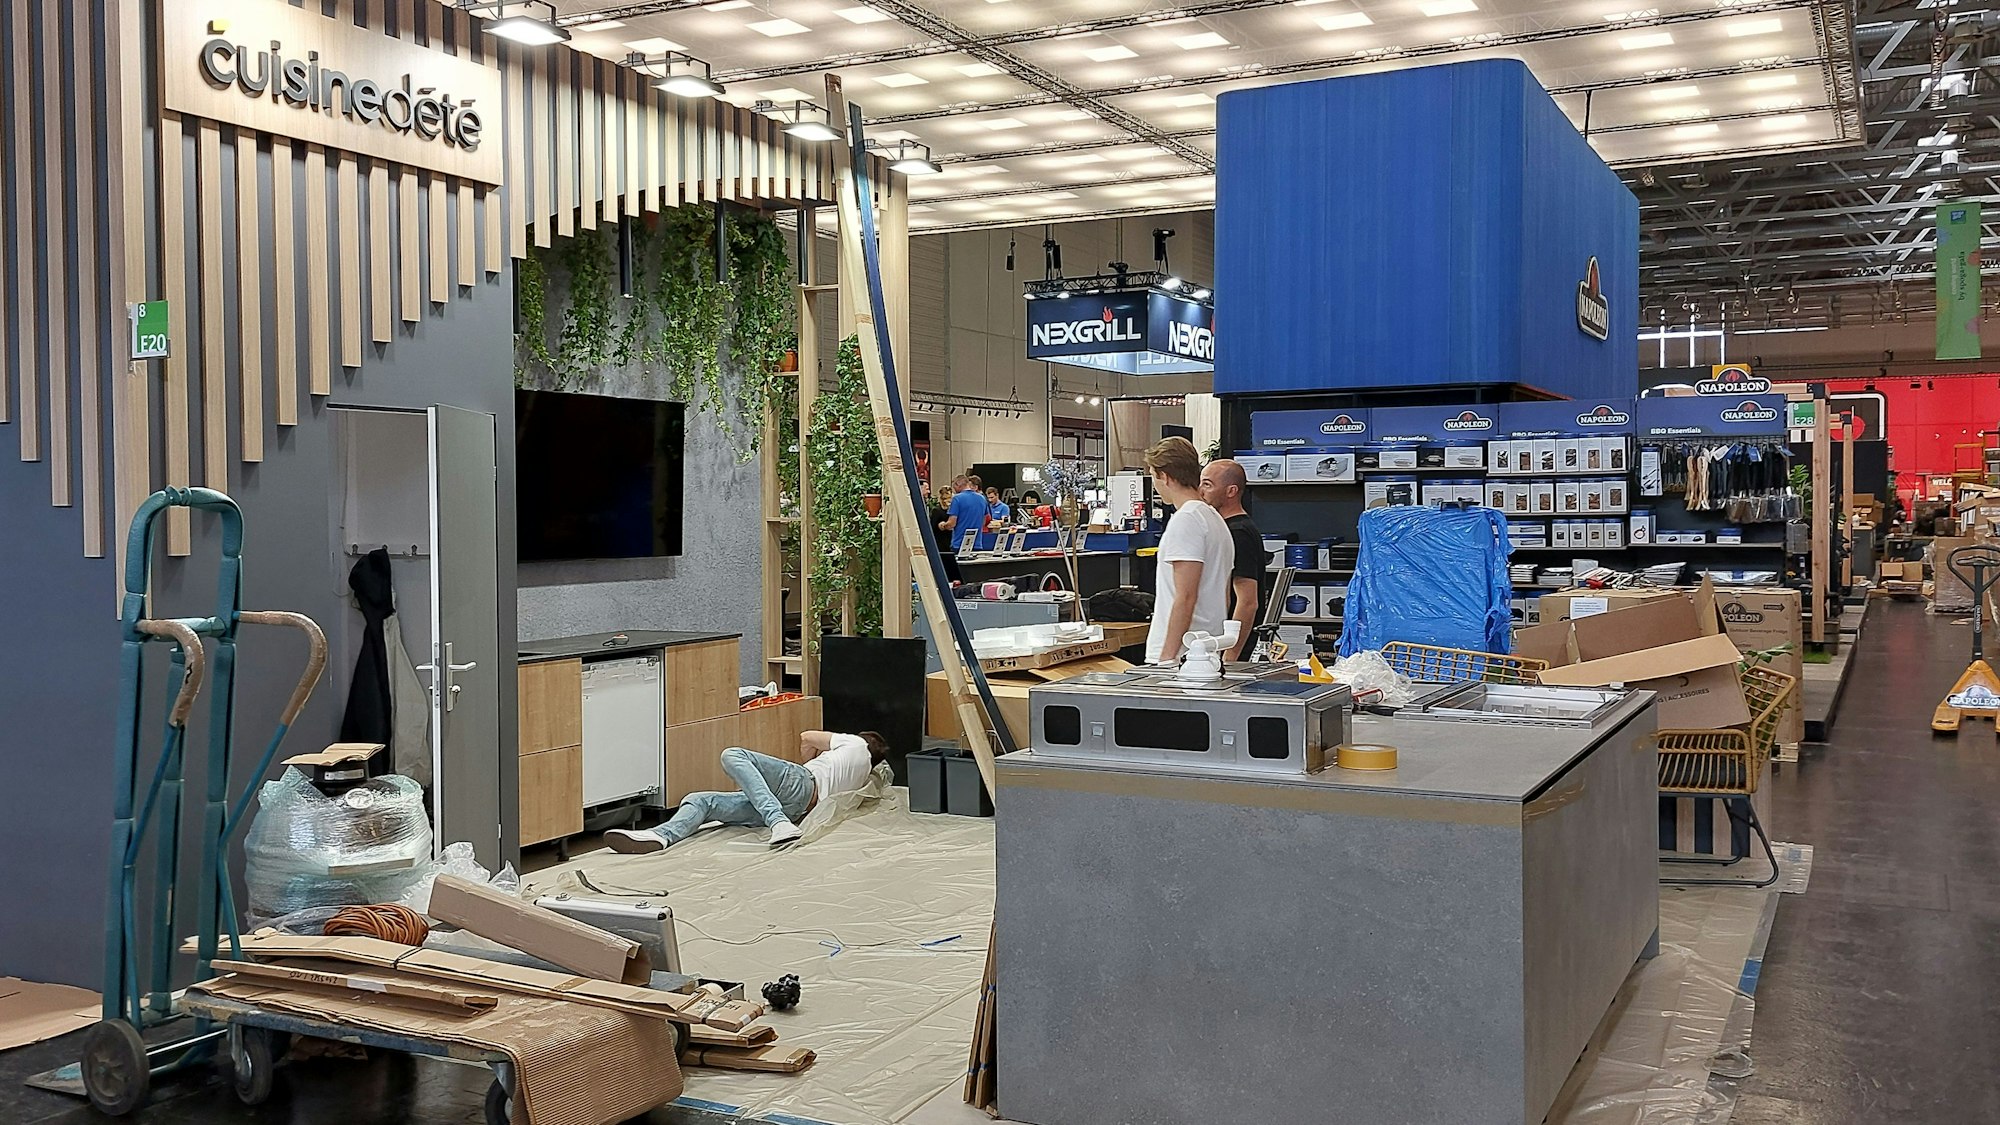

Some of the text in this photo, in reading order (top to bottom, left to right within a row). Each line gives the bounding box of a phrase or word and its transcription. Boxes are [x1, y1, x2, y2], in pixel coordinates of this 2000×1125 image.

[139, 304, 146, 317] 8
[1032, 317, 1142, 346] NEXGRILL
[141, 334, 166, 352] E20
[1168, 320, 1215, 360] NEXGRI
[1700, 381, 1766, 393] NAPOLEON
[1580, 415, 1626, 423] NAPOLEON
[1724, 411, 1773, 420] NAPOLEON
[1795, 416, 1814, 425] E28
[1447, 420, 1489, 428] NAPOLEON
